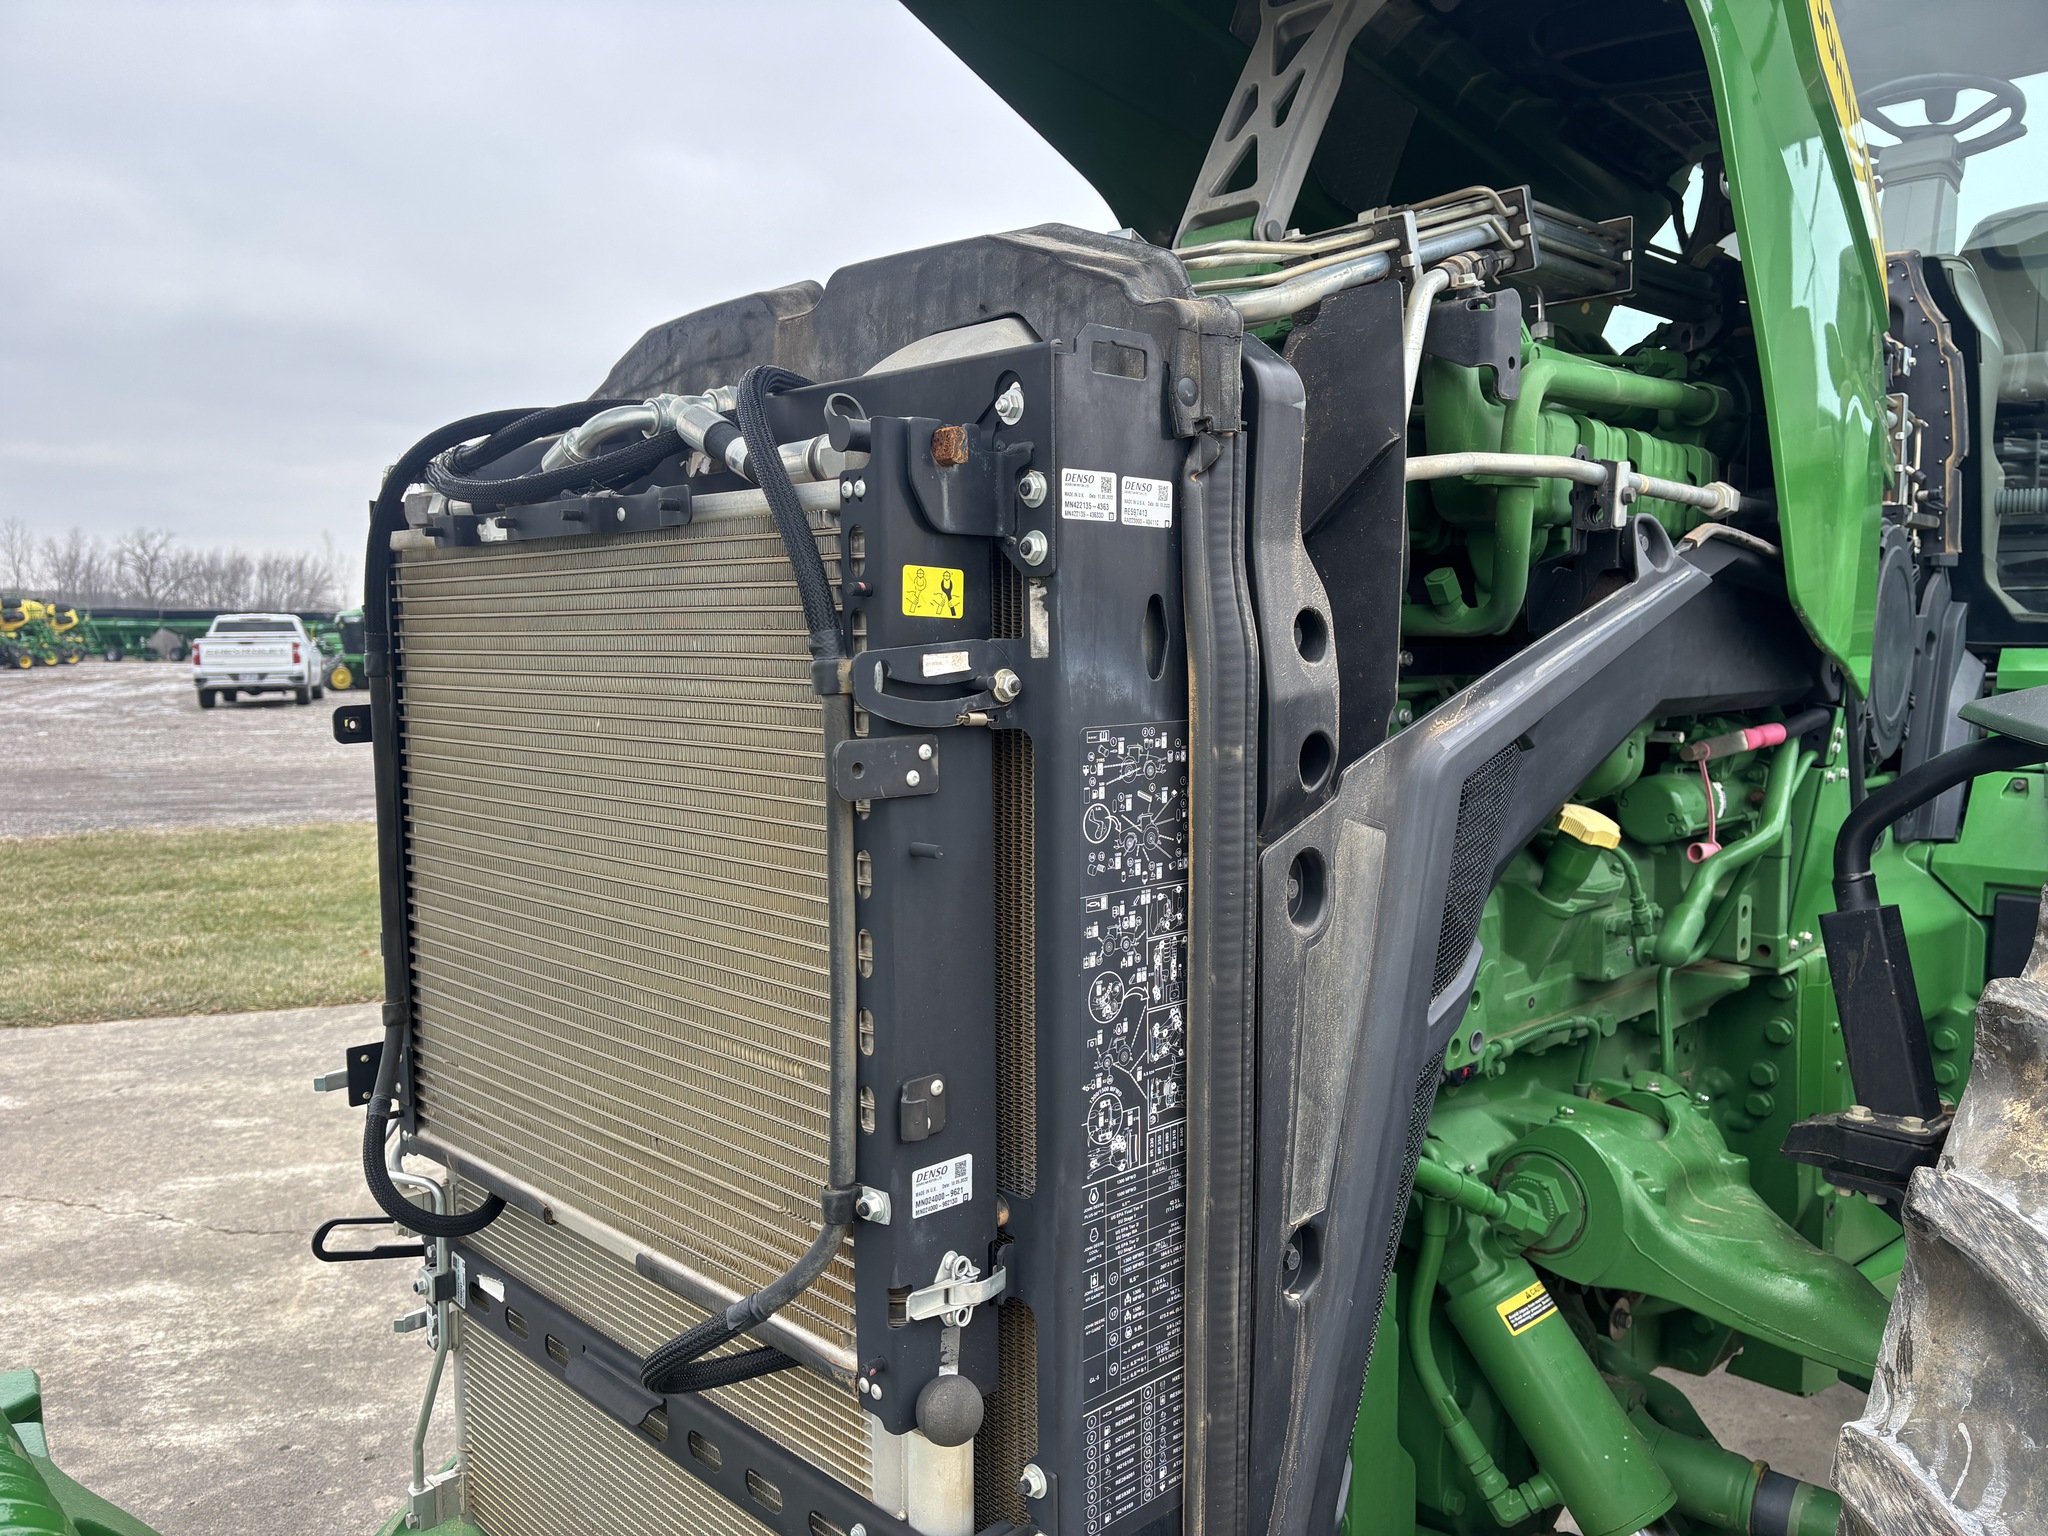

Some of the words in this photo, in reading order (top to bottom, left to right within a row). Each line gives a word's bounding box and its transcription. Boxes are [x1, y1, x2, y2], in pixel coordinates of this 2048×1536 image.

[1065, 472, 1095, 485] DENSO
[1125, 480, 1152, 493] DENSO
[205, 647, 287, 656] CHEVROLET
[916, 1165, 948, 1183] DENSO
